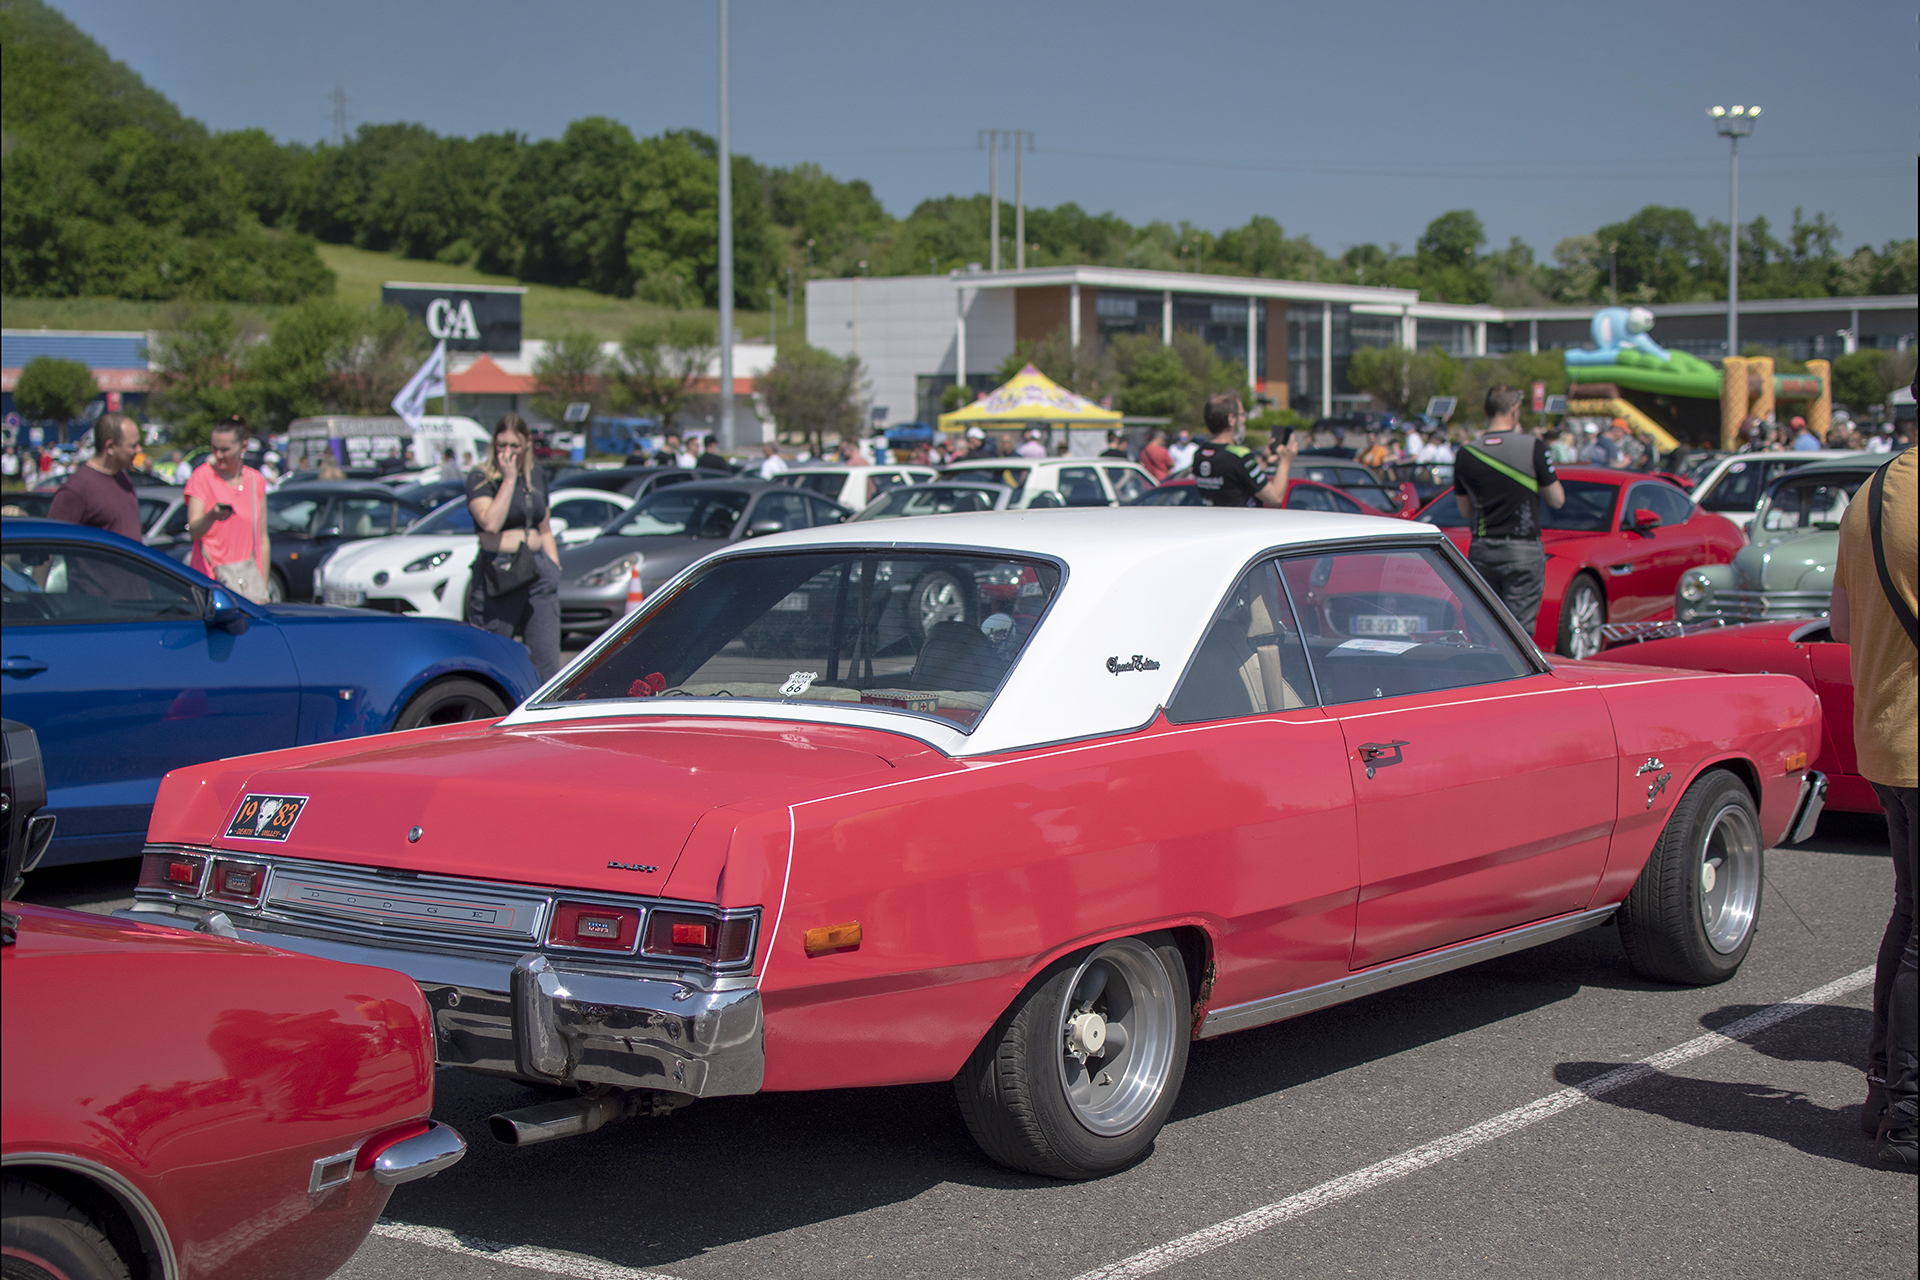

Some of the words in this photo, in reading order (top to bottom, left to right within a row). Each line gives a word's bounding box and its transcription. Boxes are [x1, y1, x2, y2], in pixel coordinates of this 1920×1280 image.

[426, 298, 481, 339] C&A
[786, 684, 802, 692] 66
[236, 801, 258, 824] 19
[273, 803, 299, 827] 83
[607, 861, 659, 873] DART
[311, 891, 484, 919] DODGE
